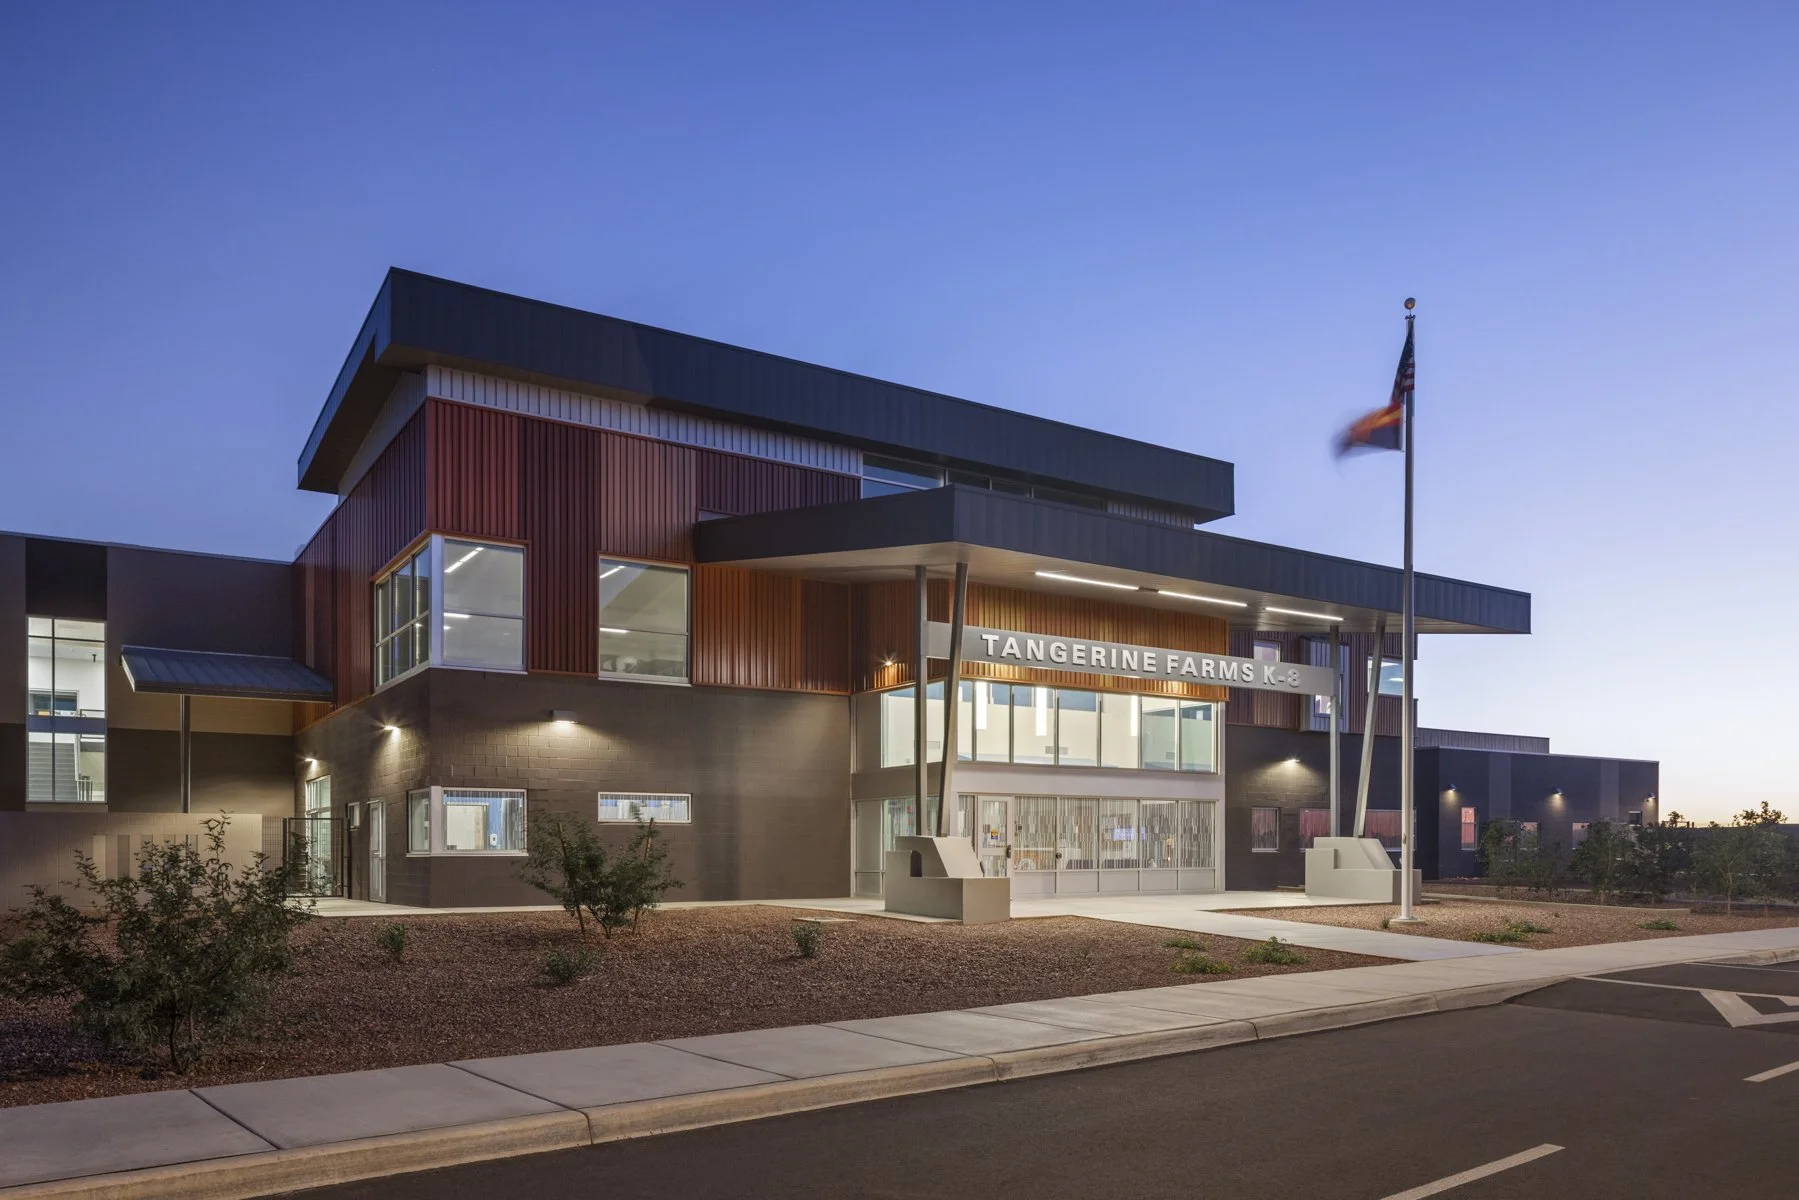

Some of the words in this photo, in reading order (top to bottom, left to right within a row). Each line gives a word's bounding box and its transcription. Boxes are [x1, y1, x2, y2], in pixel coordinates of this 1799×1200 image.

[981, 634, 1157, 672] TANGERINE
[1166, 655, 1255, 682] FARMS
[1263, 665, 1301, 688] K-8
